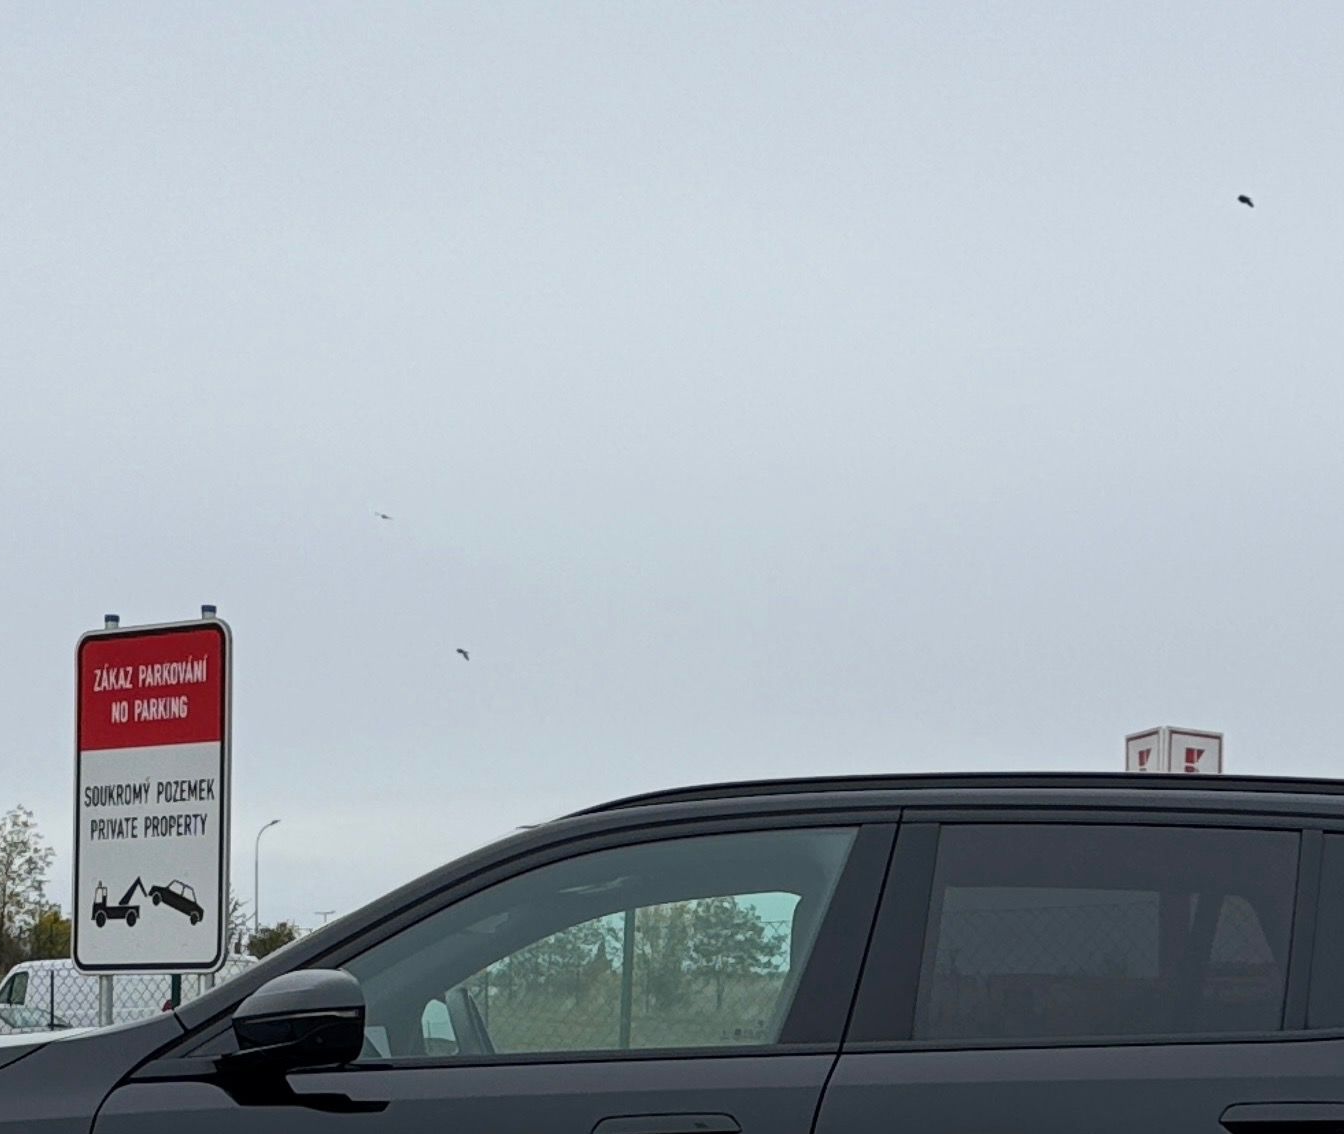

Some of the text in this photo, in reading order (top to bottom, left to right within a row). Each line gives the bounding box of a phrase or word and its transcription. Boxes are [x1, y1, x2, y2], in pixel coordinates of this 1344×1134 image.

[93, 654, 208, 692] ZÁKAZ PARKOVÁNÍ
[111, 695, 188, 723] NO PARKING
[84, 776, 215, 807] SOUKROMÝ POZEMEK
[90, 813, 207, 840] PRIVATE PROPERTY
